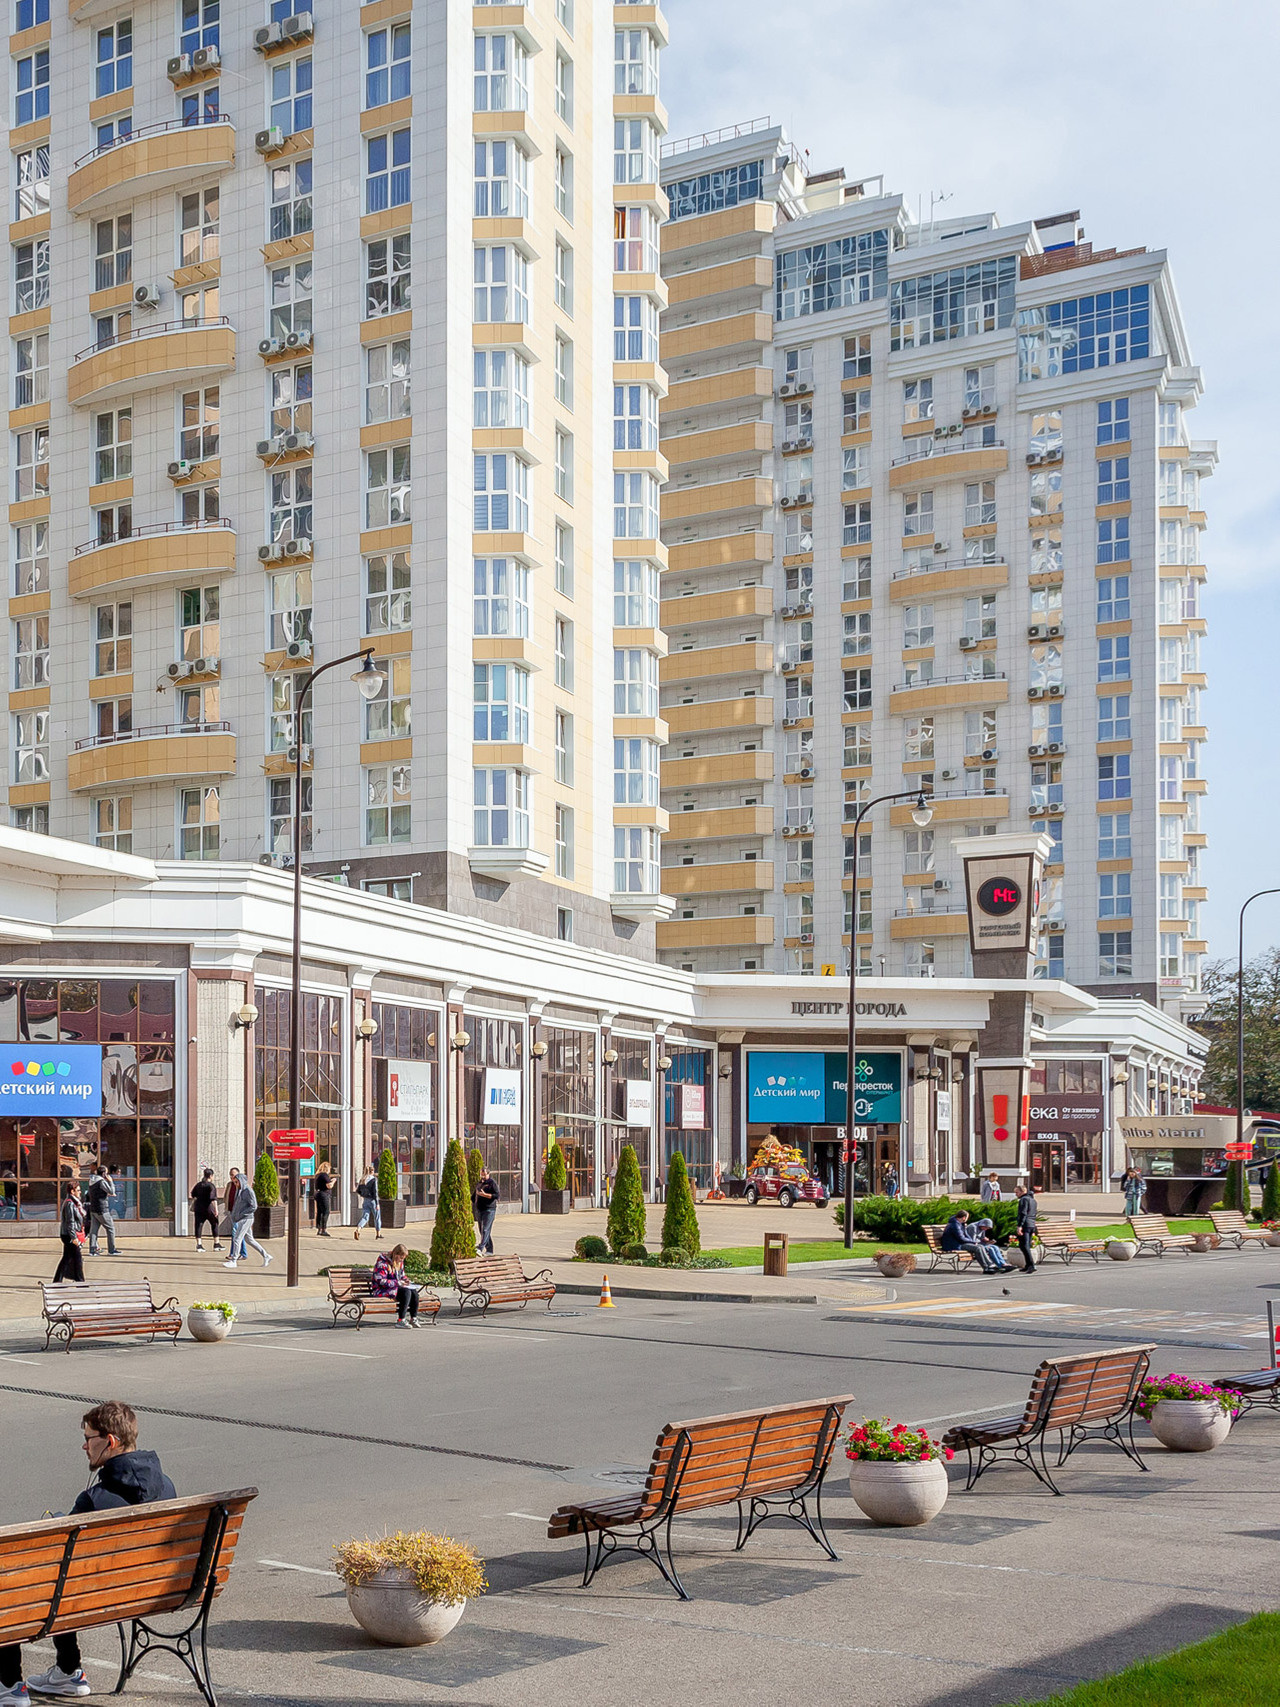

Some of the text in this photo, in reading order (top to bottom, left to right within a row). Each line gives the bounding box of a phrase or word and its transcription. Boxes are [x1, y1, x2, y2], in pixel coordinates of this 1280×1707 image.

[792, 1002, 844, 1016] ЦЕНТР
[60, 1083, 92, 1100] мир
[754, 1087, 820, 1099] Детский мир
[837, 1127, 868, 1140] ВОД
[1158, 1128, 1206, 1138] Meinl
